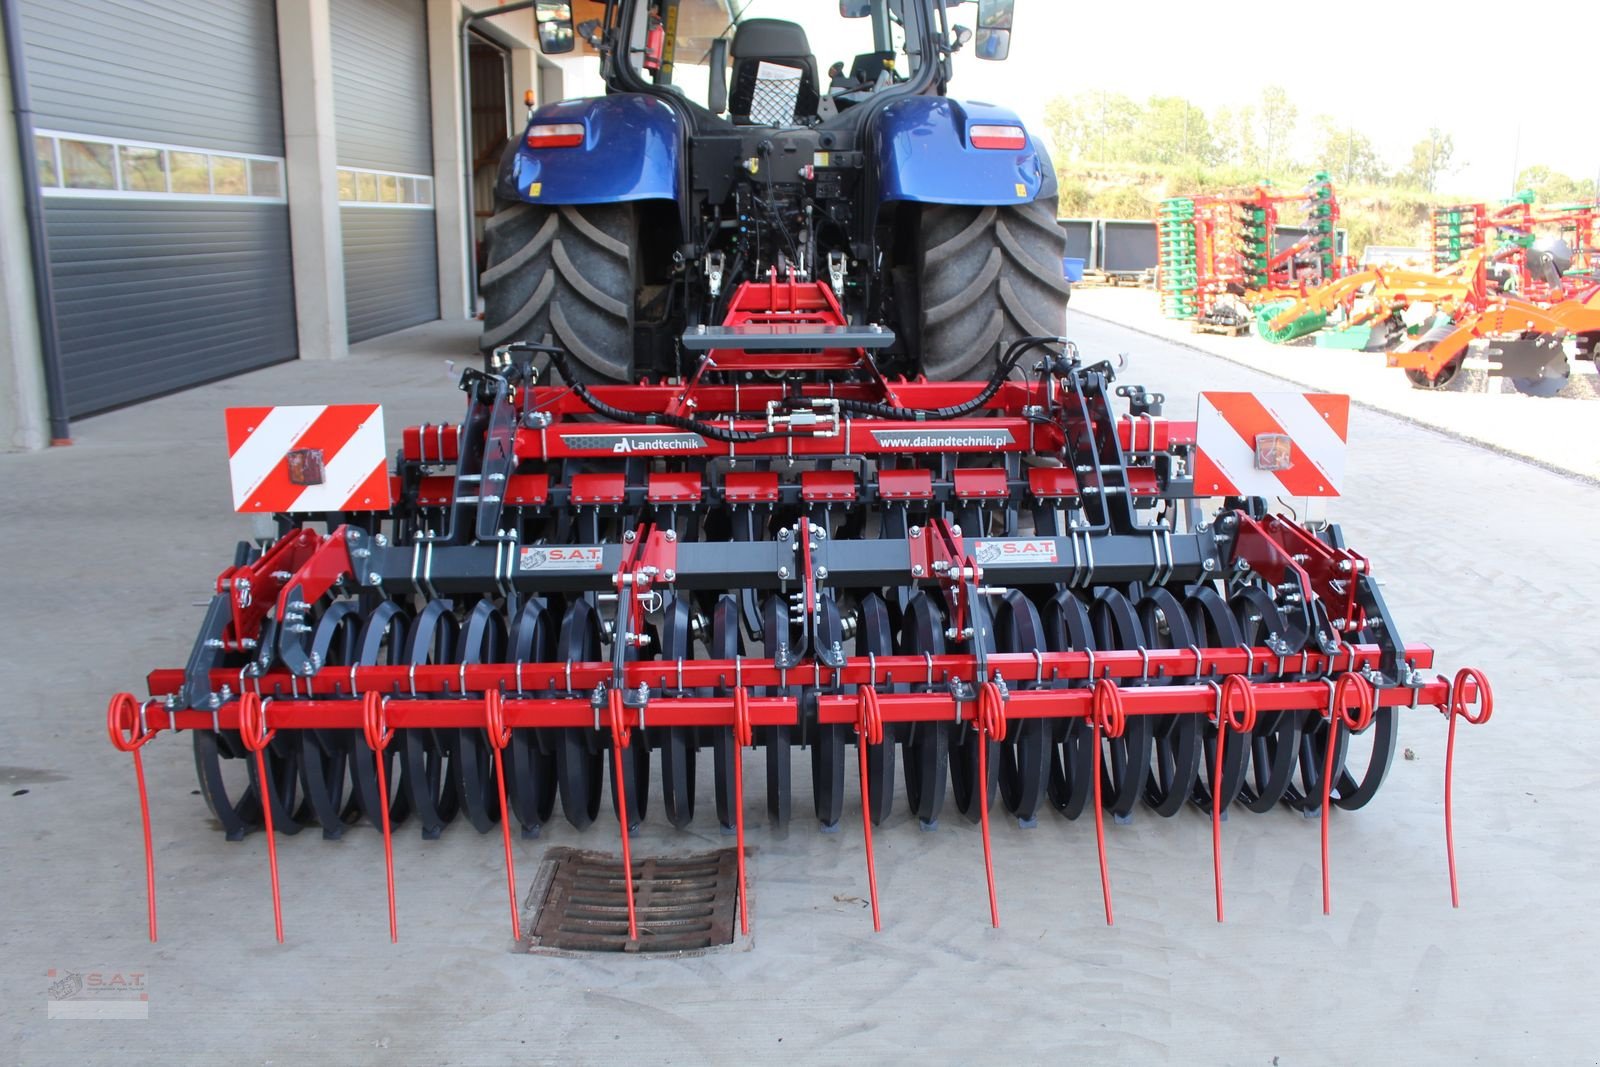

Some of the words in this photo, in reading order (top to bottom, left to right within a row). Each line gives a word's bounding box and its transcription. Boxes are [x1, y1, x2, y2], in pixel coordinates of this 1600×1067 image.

[632, 439, 699, 450] Landtechnik
[880, 436, 1007, 449] www.dalandtechnik.pl
[1003, 542, 1055, 553] S.A.T.
[549, 549, 601, 560] S.A.T.
